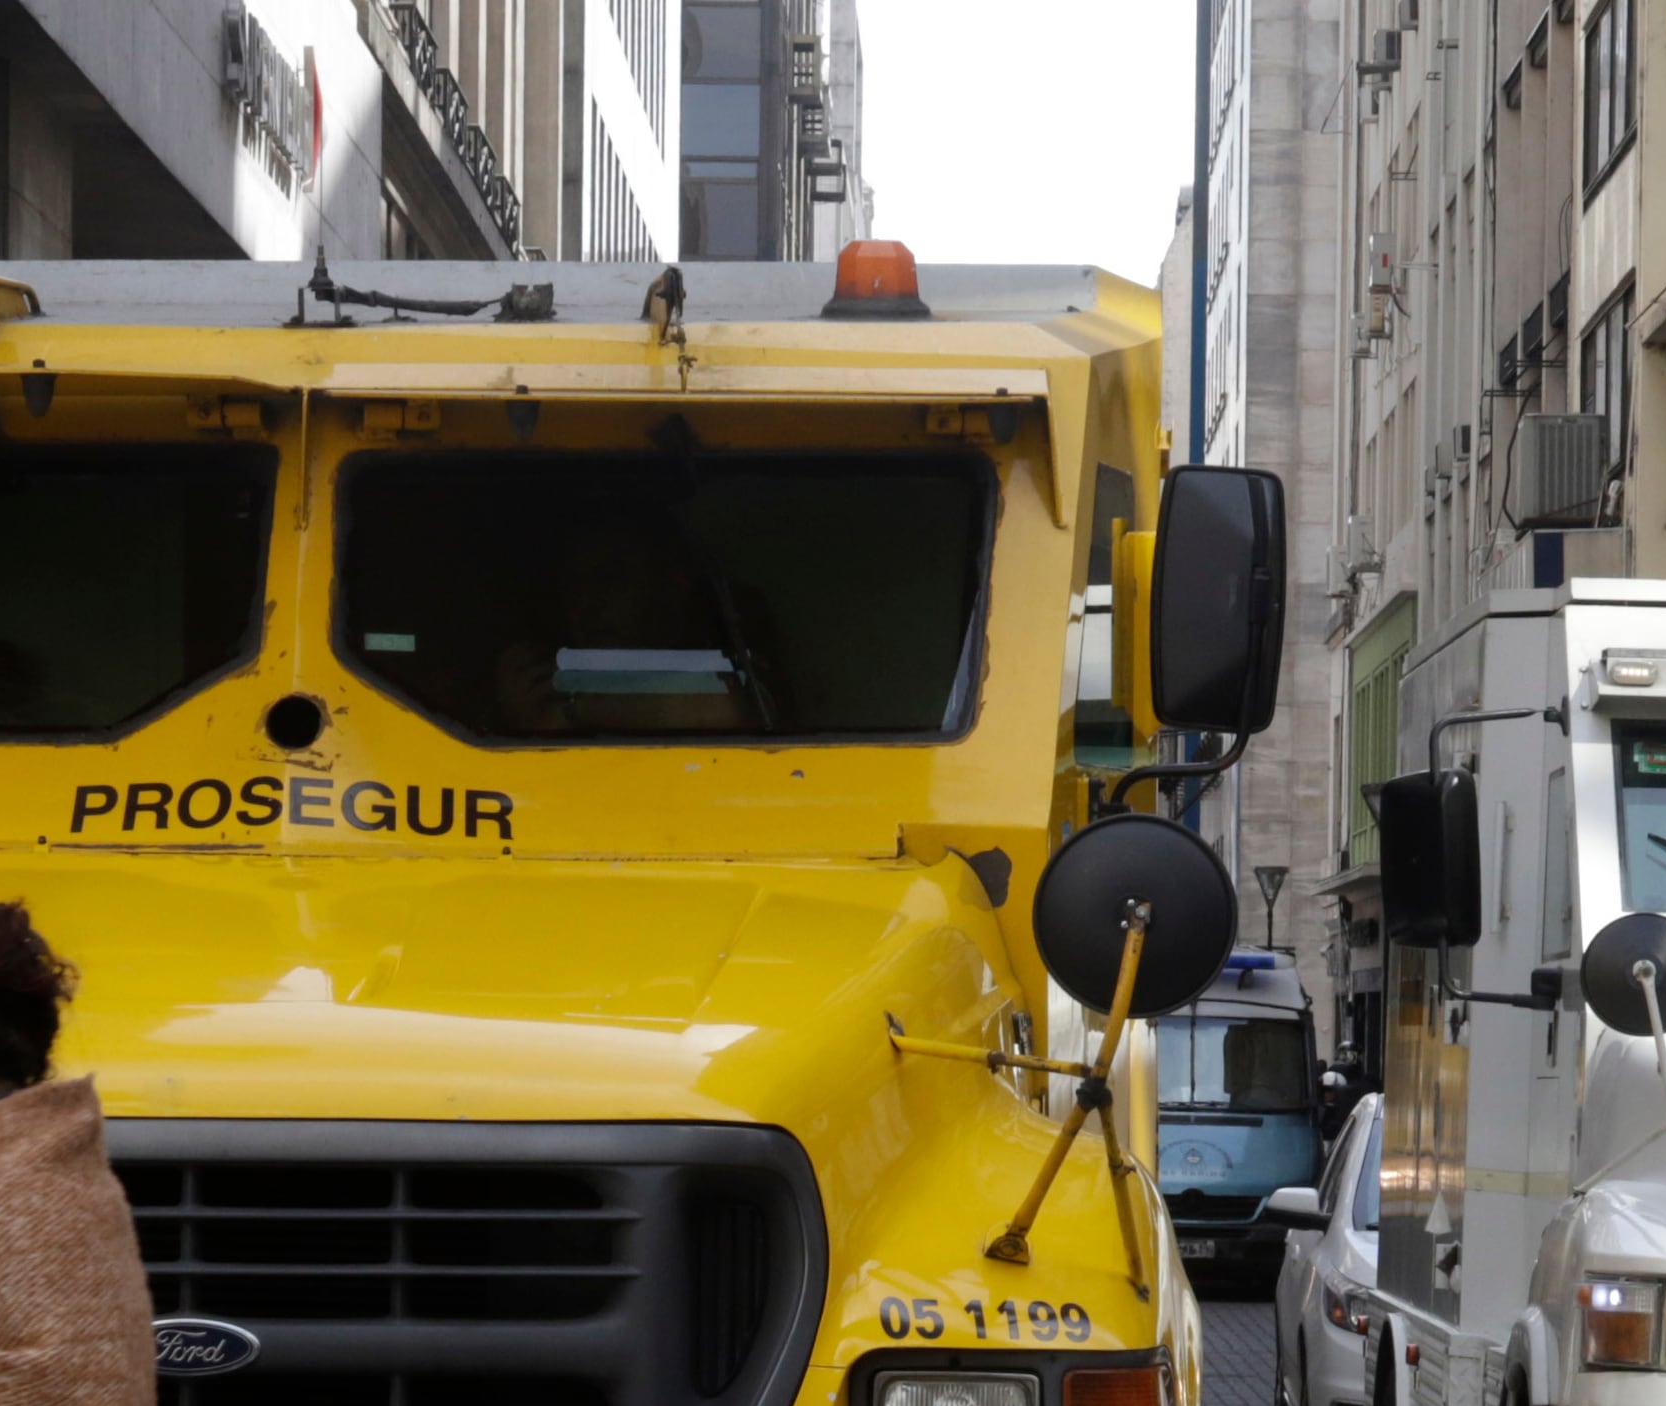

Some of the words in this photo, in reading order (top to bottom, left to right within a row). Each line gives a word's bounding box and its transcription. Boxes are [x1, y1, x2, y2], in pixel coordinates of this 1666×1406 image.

[69, 775, 514, 840] PROSEGUR
[879, 1296, 945, 1340] 05
[964, 1299, 1092, 1343] 1199
[155, 1328, 226, 1363] Ford
